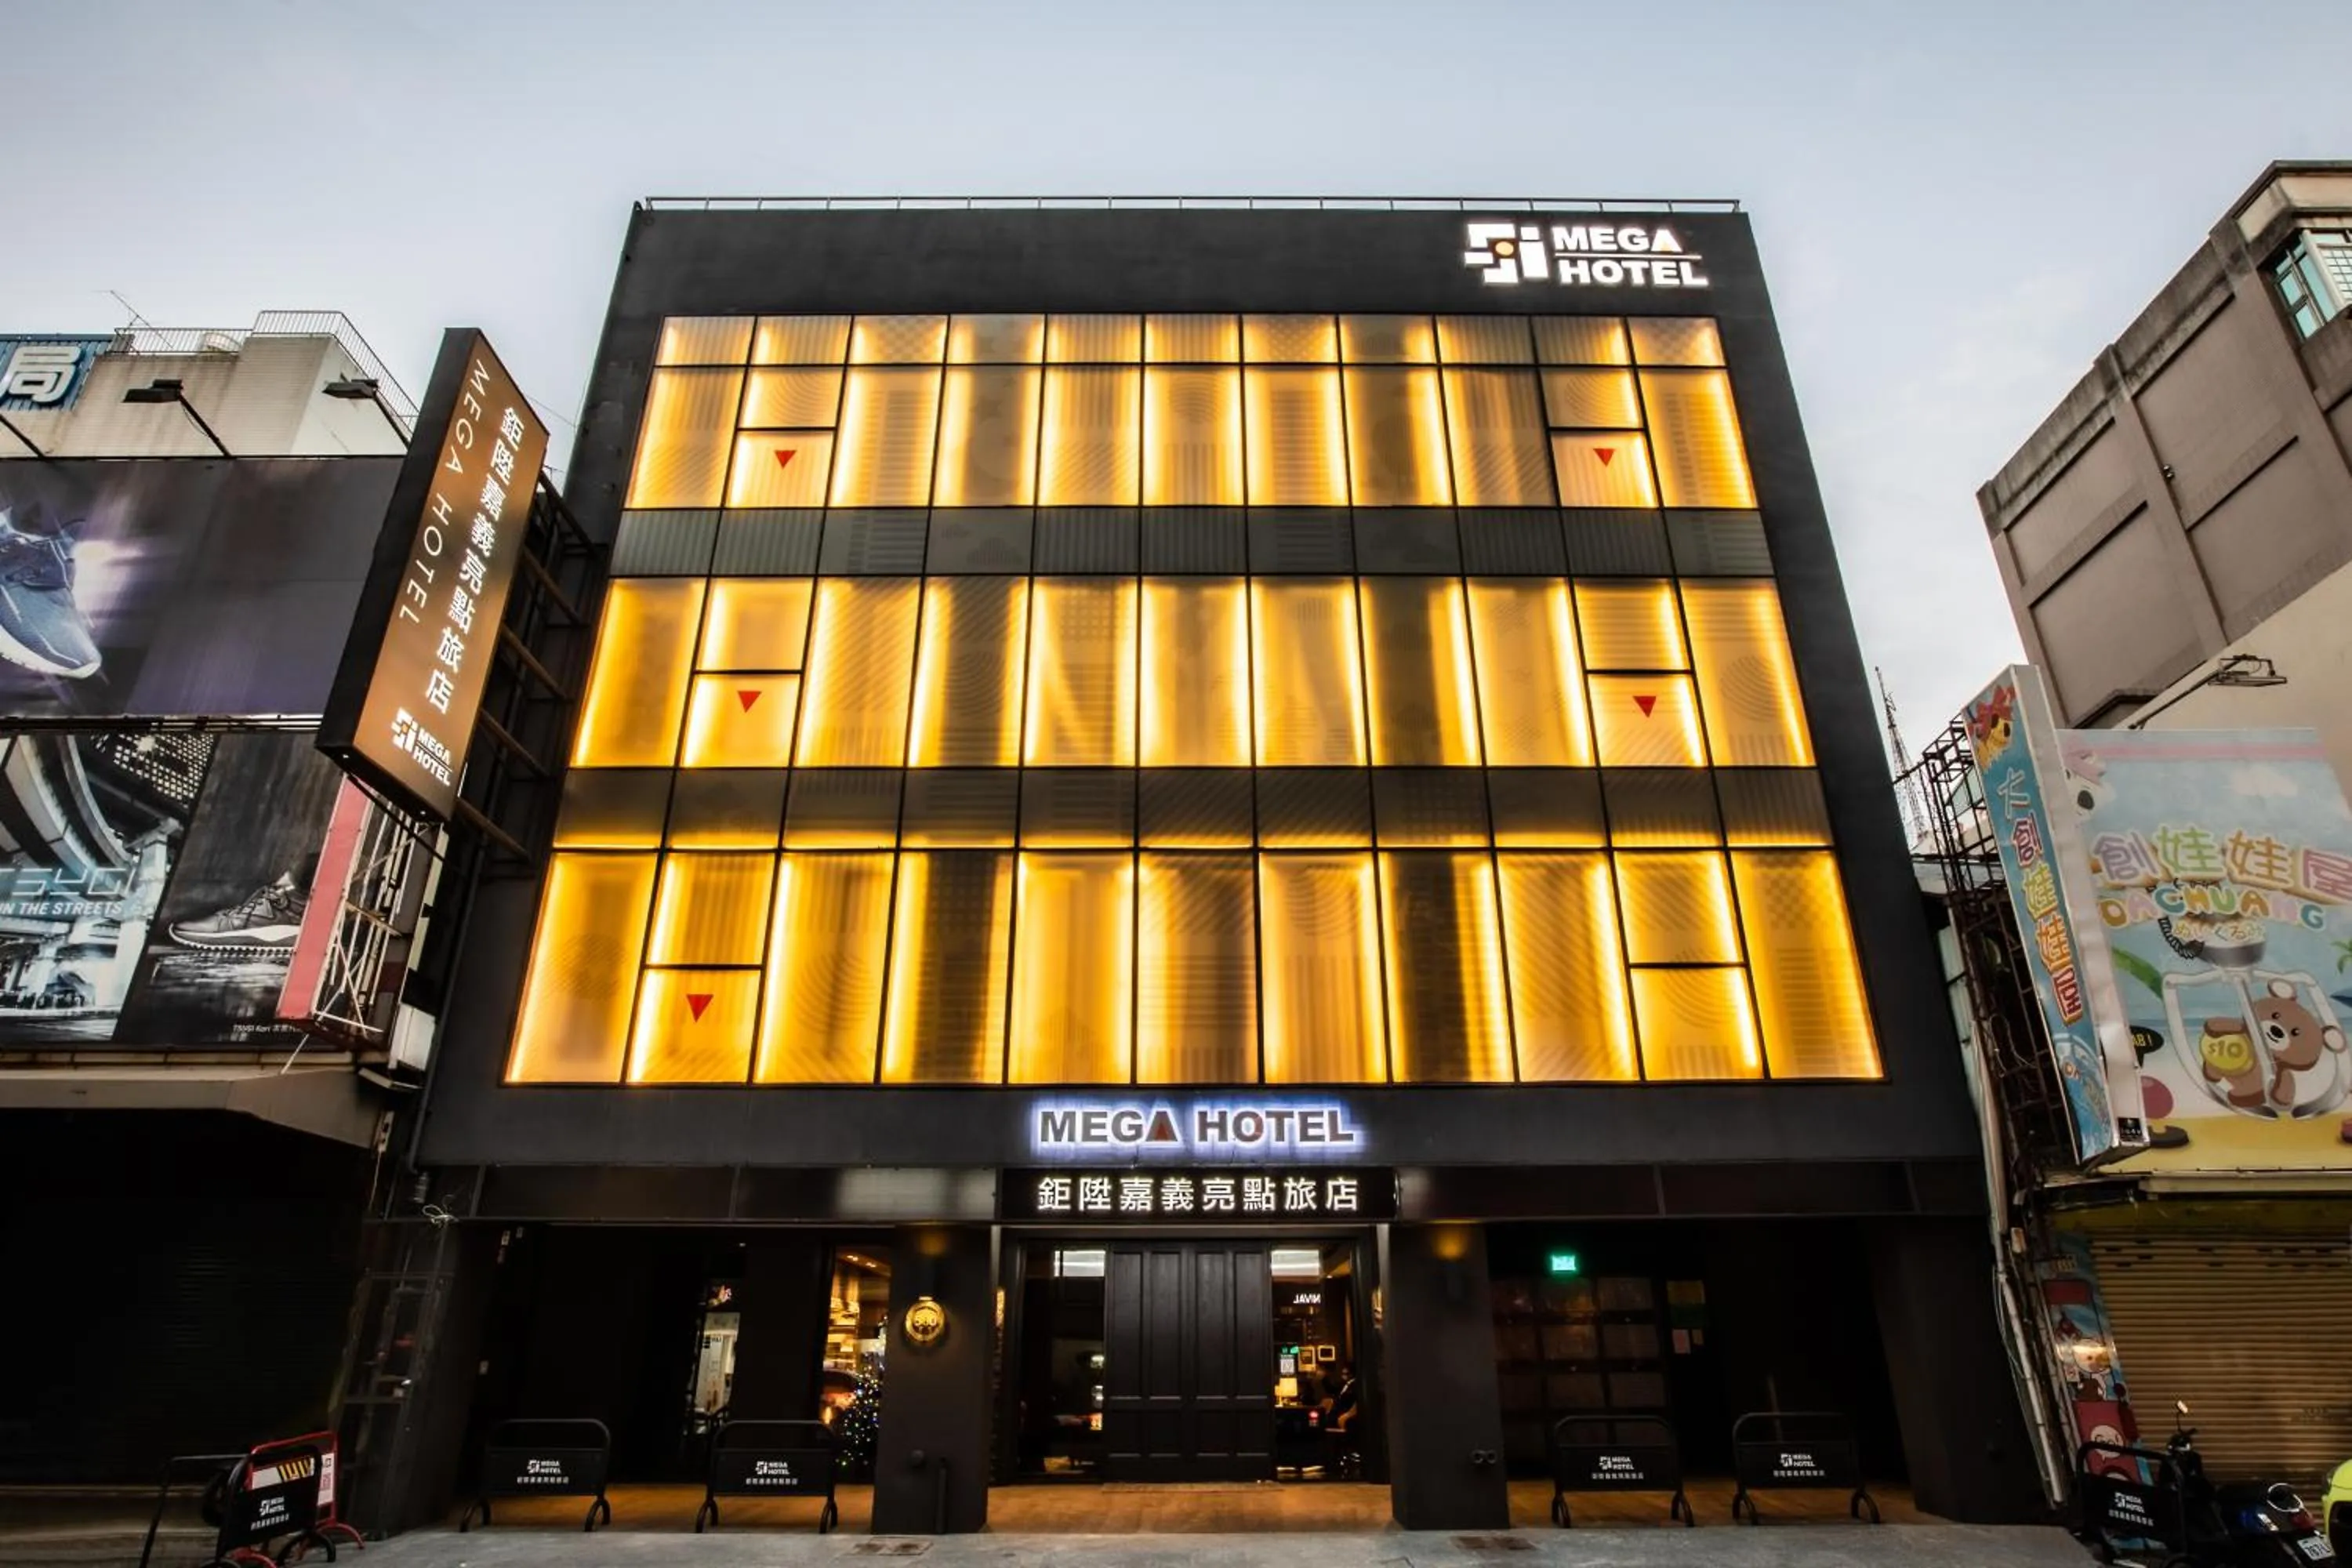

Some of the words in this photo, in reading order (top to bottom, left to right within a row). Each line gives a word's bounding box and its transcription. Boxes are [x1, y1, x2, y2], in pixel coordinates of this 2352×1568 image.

[1551, 226, 1682, 252] MEGA
[1557, 260, 1709, 286] HOTEL
[0, 346, 82, 403] 局
[445, 358, 491, 474] MEGA
[399, 492, 452, 623] HOTEL
[425, 407, 524, 715] 鉅陞嘉義亮點旅店
[416, 728, 452, 766] MEGA
[413, 749, 451, 786] HOTEL
[2089, 826, 2352, 903] 創娃娃屋
[20, 902, 49, 915] THE
[52, 902, 123, 915] STREETS
[1997, 767, 2083, 1025] 大創娃娃屋
[2208, 1040, 2245, 1058] $10
[1040, 1110, 1178, 1143] MEGA
[1197, 1110, 1354, 1143] HOTEL
[1037, 1178, 1359, 1212] 鉅陞嘉義亮點旅店
